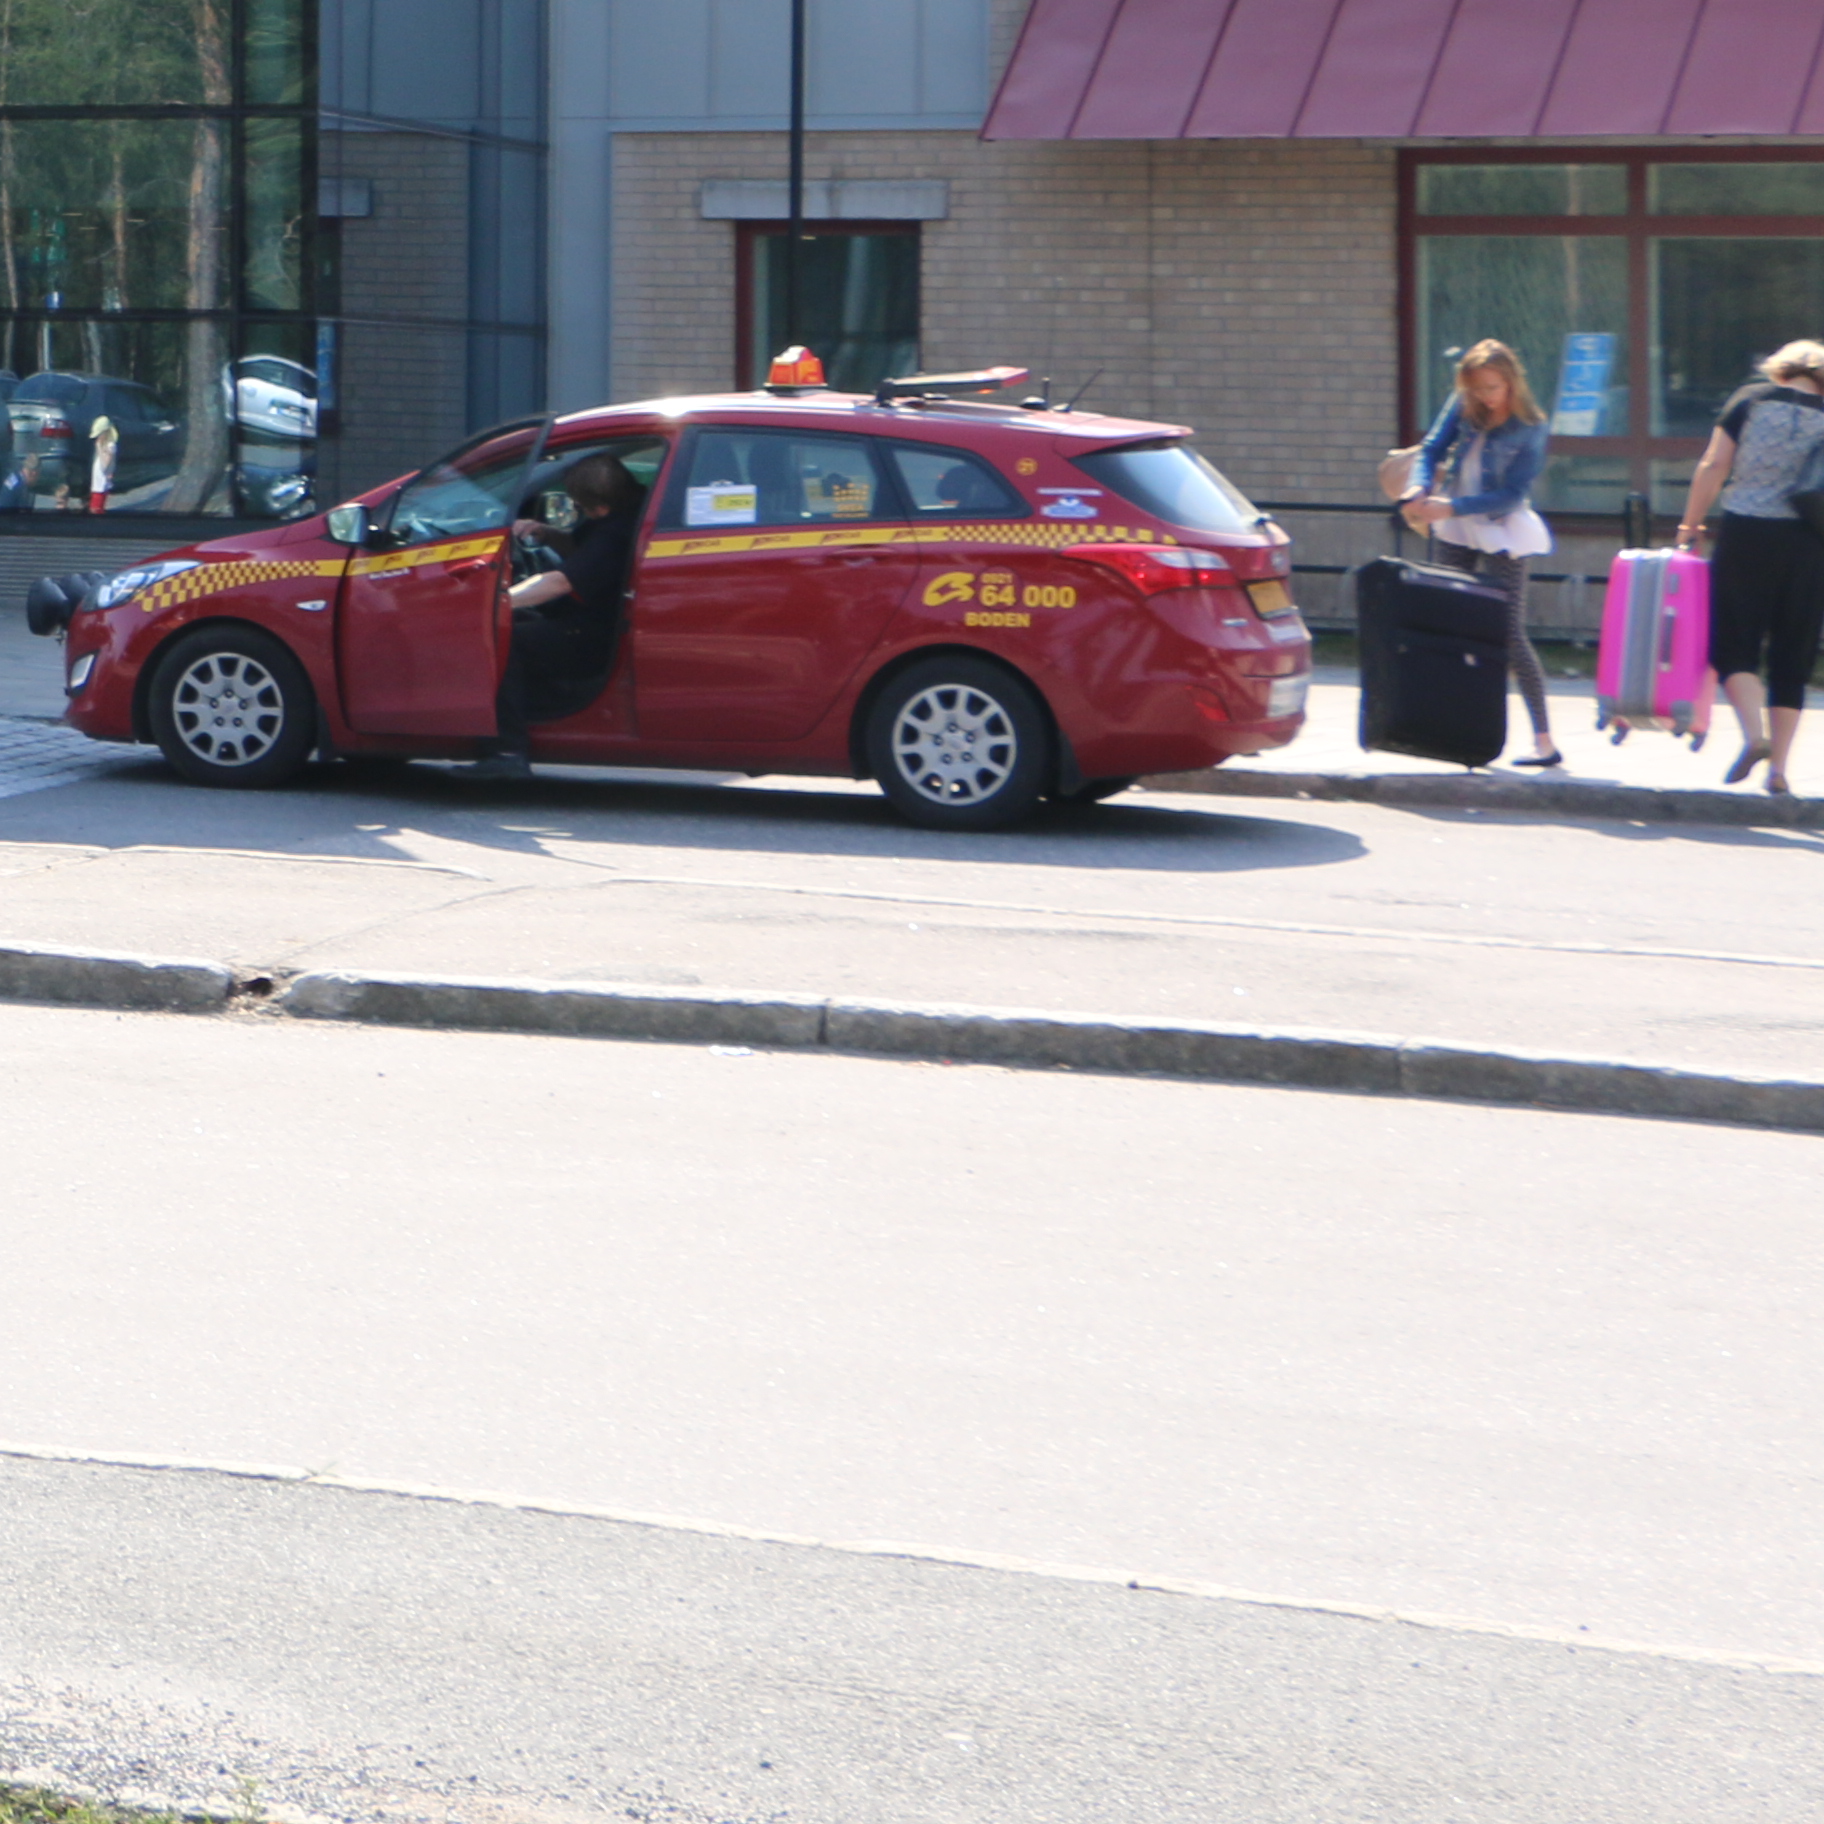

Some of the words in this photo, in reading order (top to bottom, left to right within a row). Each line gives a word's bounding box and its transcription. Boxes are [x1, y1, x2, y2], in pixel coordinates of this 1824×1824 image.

[980, 584, 1016, 607] 64
[1022, 585, 1077, 608] 000
[965, 612, 1031, 628] BODEN
